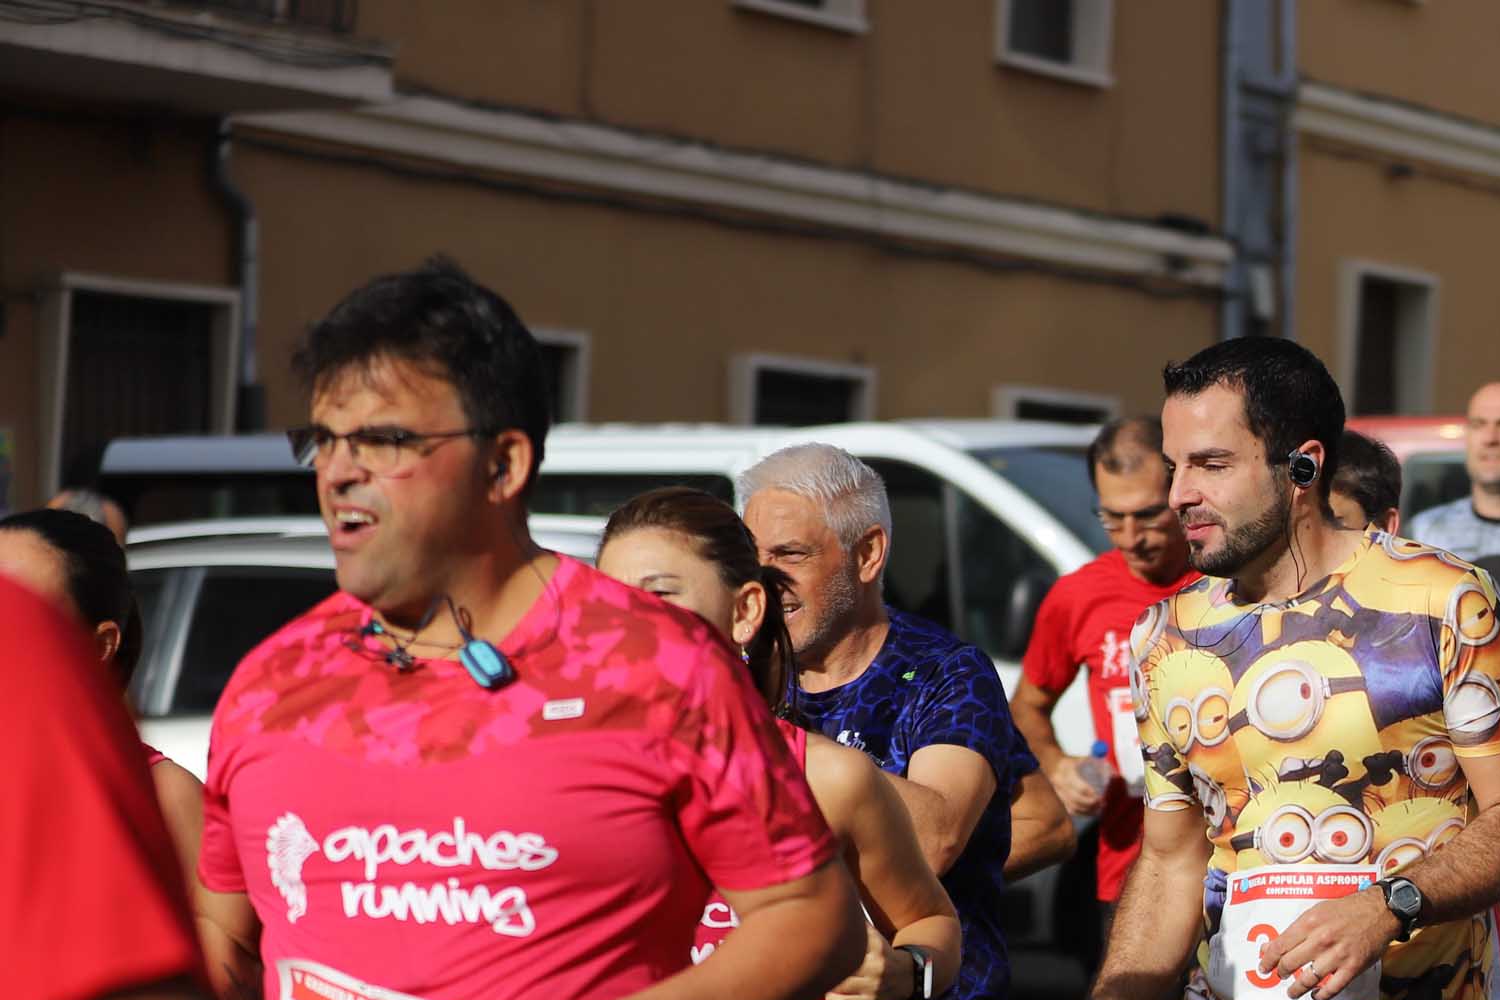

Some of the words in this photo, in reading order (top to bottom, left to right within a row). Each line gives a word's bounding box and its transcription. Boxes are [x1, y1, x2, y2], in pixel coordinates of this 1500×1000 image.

[324, 817, 558, 880] apaches
[341, 877, 535, 937] running
[1268, 874, 1314, 885] POPULAR
